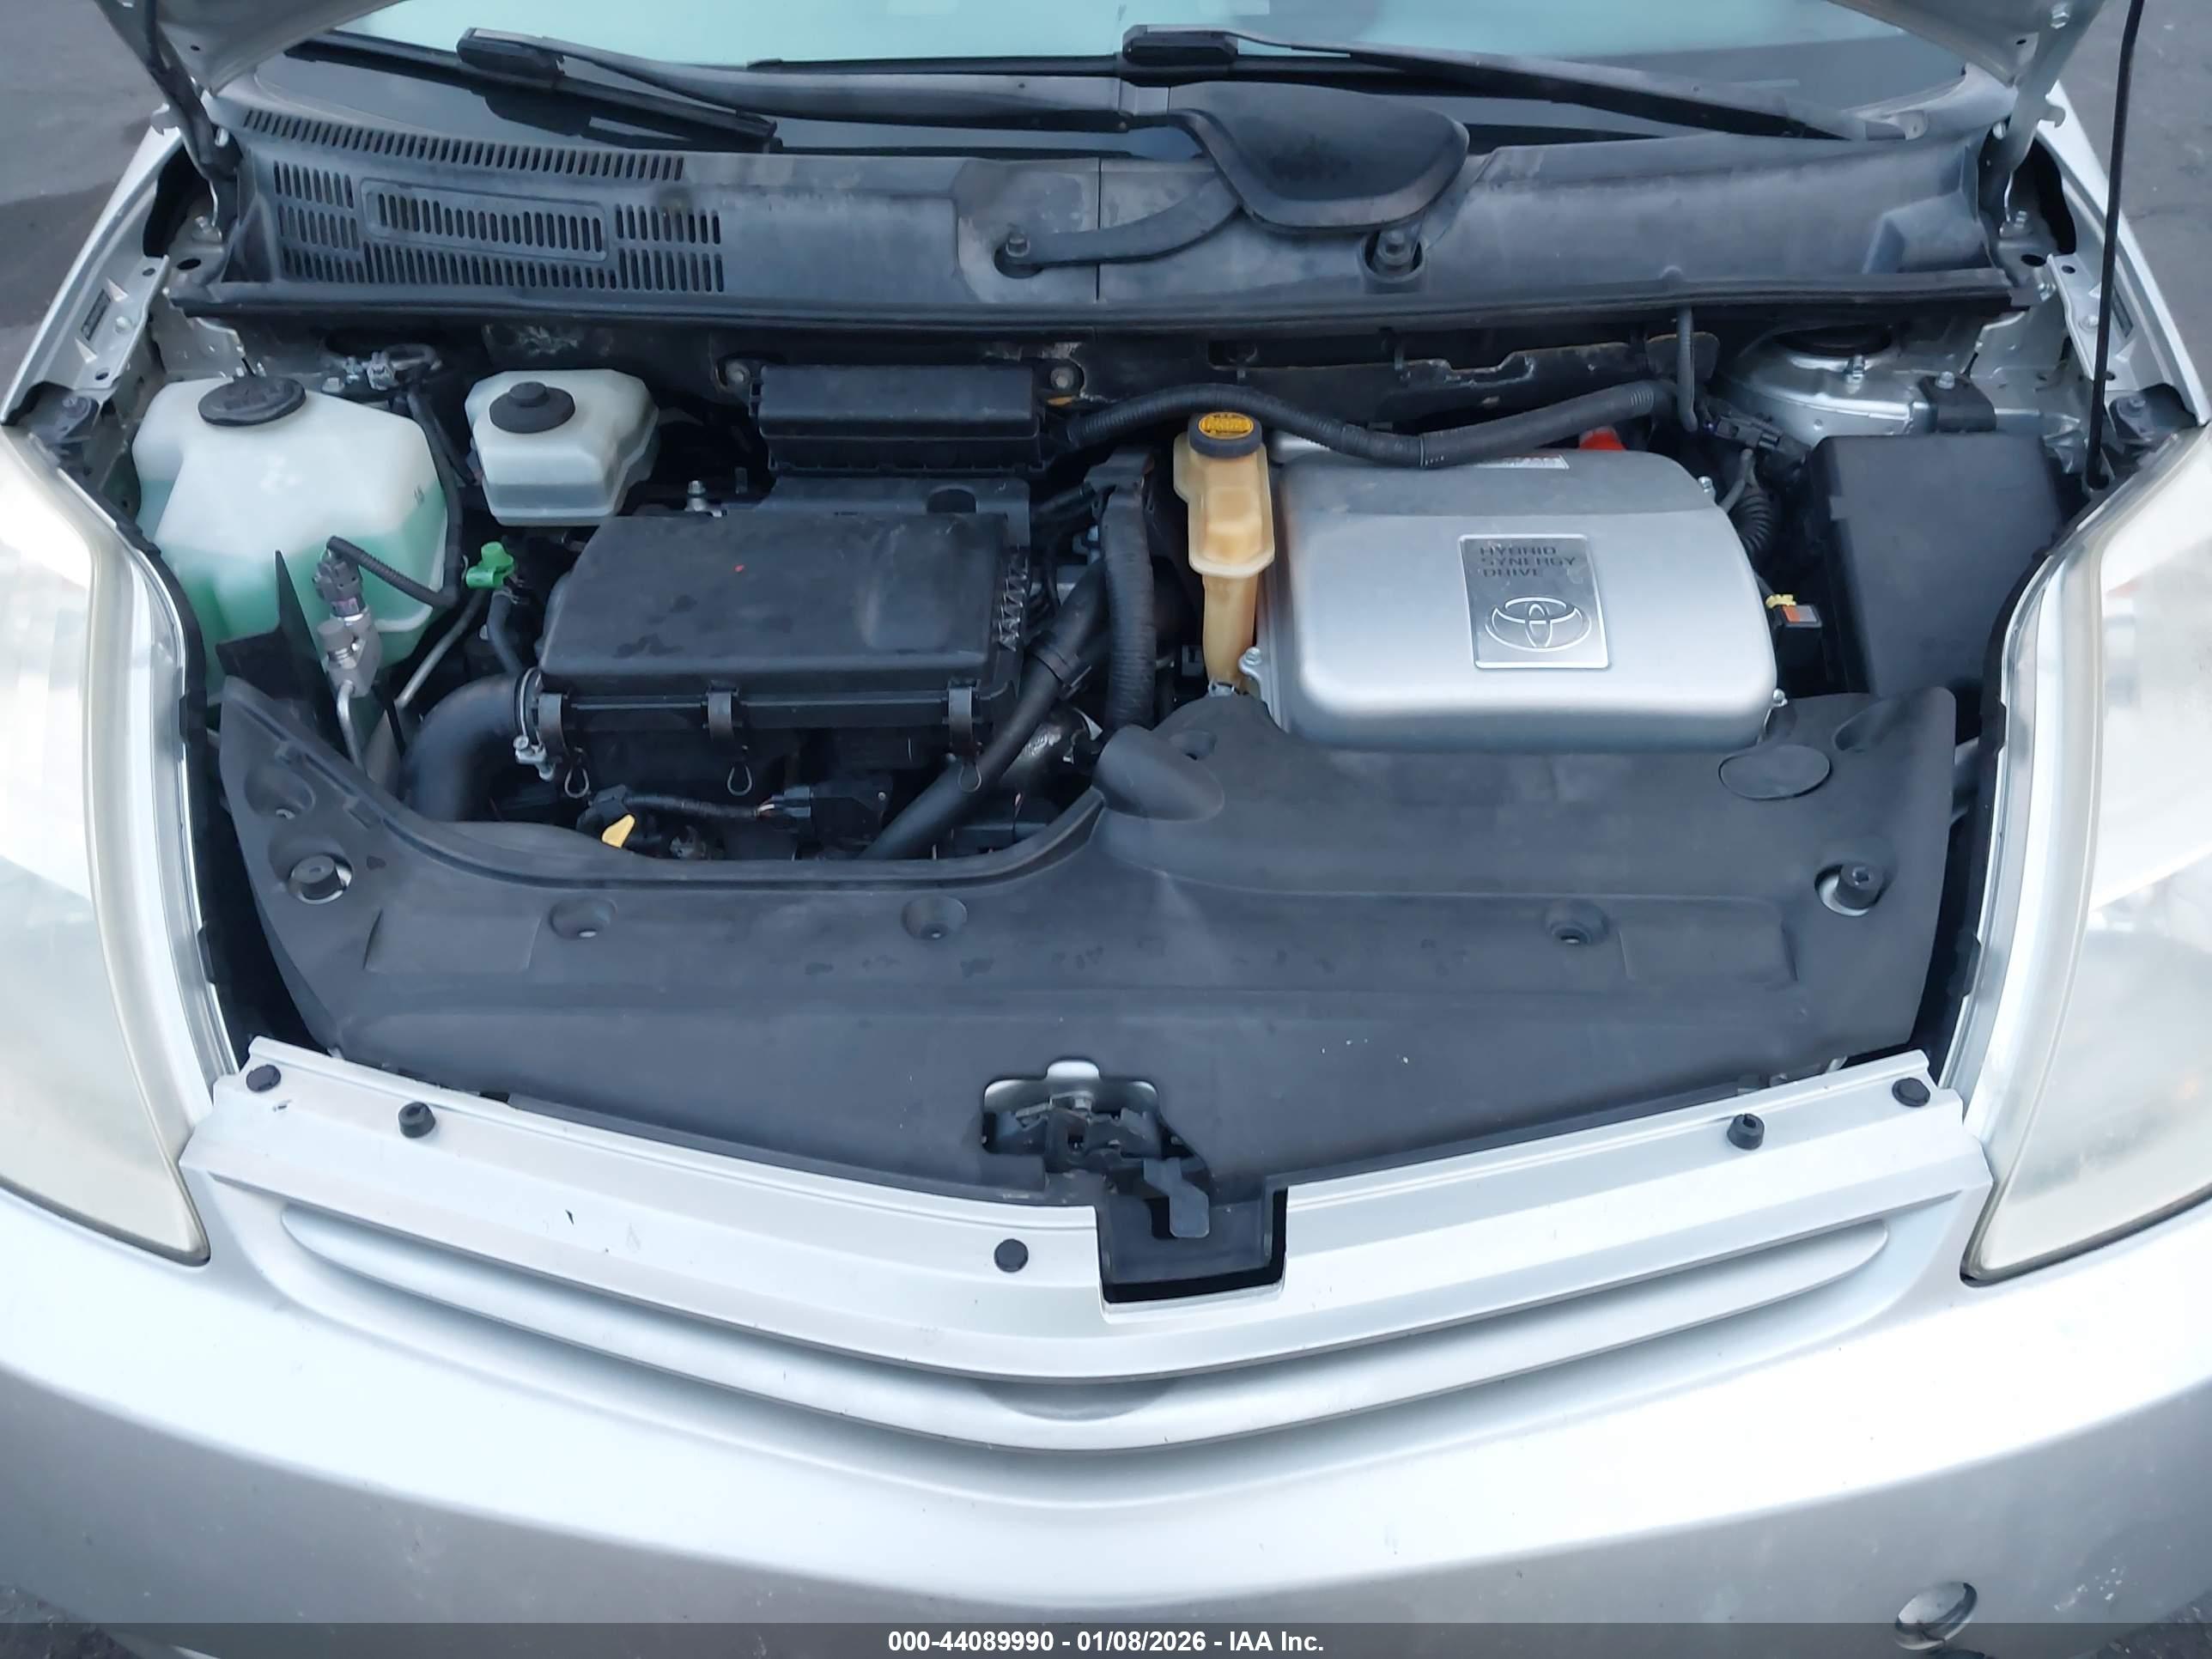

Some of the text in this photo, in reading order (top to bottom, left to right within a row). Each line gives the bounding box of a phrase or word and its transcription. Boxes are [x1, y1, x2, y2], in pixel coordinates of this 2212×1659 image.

[1480, 546, 1556, 556] HYBRID
[1480, 556, 1576, 567] SYNERGY
[1482, 568, 1540, 578] DRIVE
